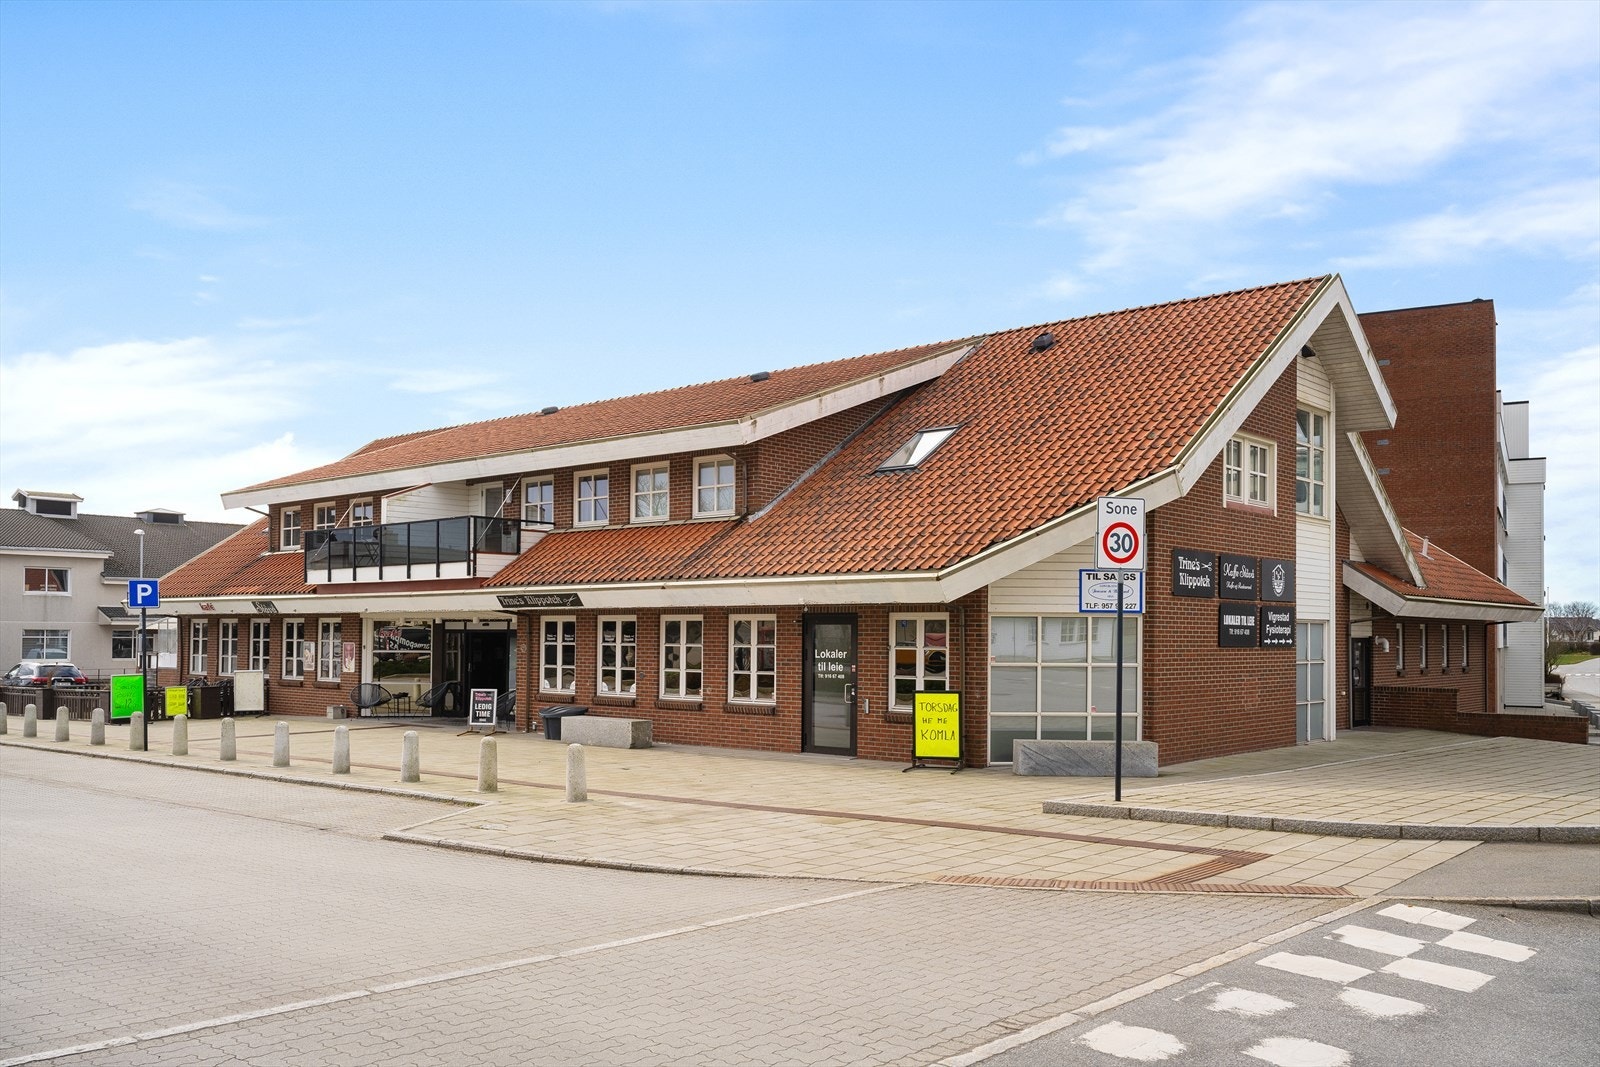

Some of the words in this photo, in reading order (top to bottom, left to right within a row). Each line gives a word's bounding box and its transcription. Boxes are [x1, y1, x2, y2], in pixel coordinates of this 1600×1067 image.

[1106, 501, 1137, 515] Sone
[1109, 532, 1133, 553] 30
[1178, 556, 1201, 571] Trine's
[1086, 573, 1101, 581] TIL
[1103, 573, 1136, 581] SAGS
[1179, 572, 1211, 589] Klippotek
[137, 583, 152, 604] P
[499, 596, 525, 606] Trine's
[524, 595, 563, 606] Klippotek
[1223, 614, 1241, 626] LOKALER
[1247, 615, 1255, 626] LEIE
[1268, 612, 1289, 623] Vigrestad
[1266, 624, 1291, 636] Fysioterapi
[815, 649, 847, 659] Lokaler
[818, 661, 826, 671] til
[828, 661, 844, 671] leie
[919, 702, 957, 712] TORSDAG
[920, 729, 956, 741] KOMLA
